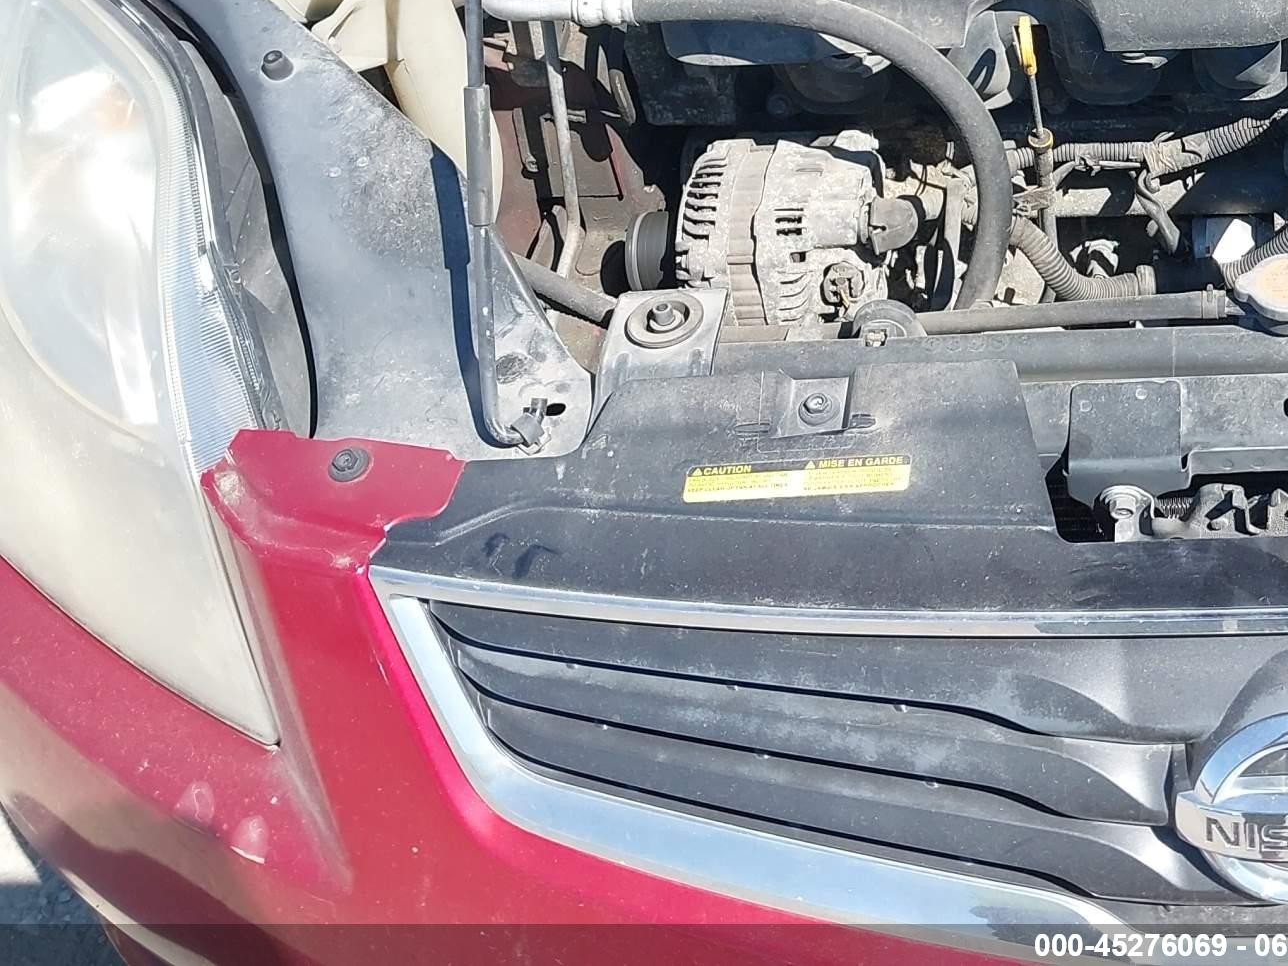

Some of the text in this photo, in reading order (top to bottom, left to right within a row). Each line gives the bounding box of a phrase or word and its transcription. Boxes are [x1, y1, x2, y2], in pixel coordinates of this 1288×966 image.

[818, 456, 904, 469] MISE EN GARDE
[703, 465, 752, 476] CAUTION
